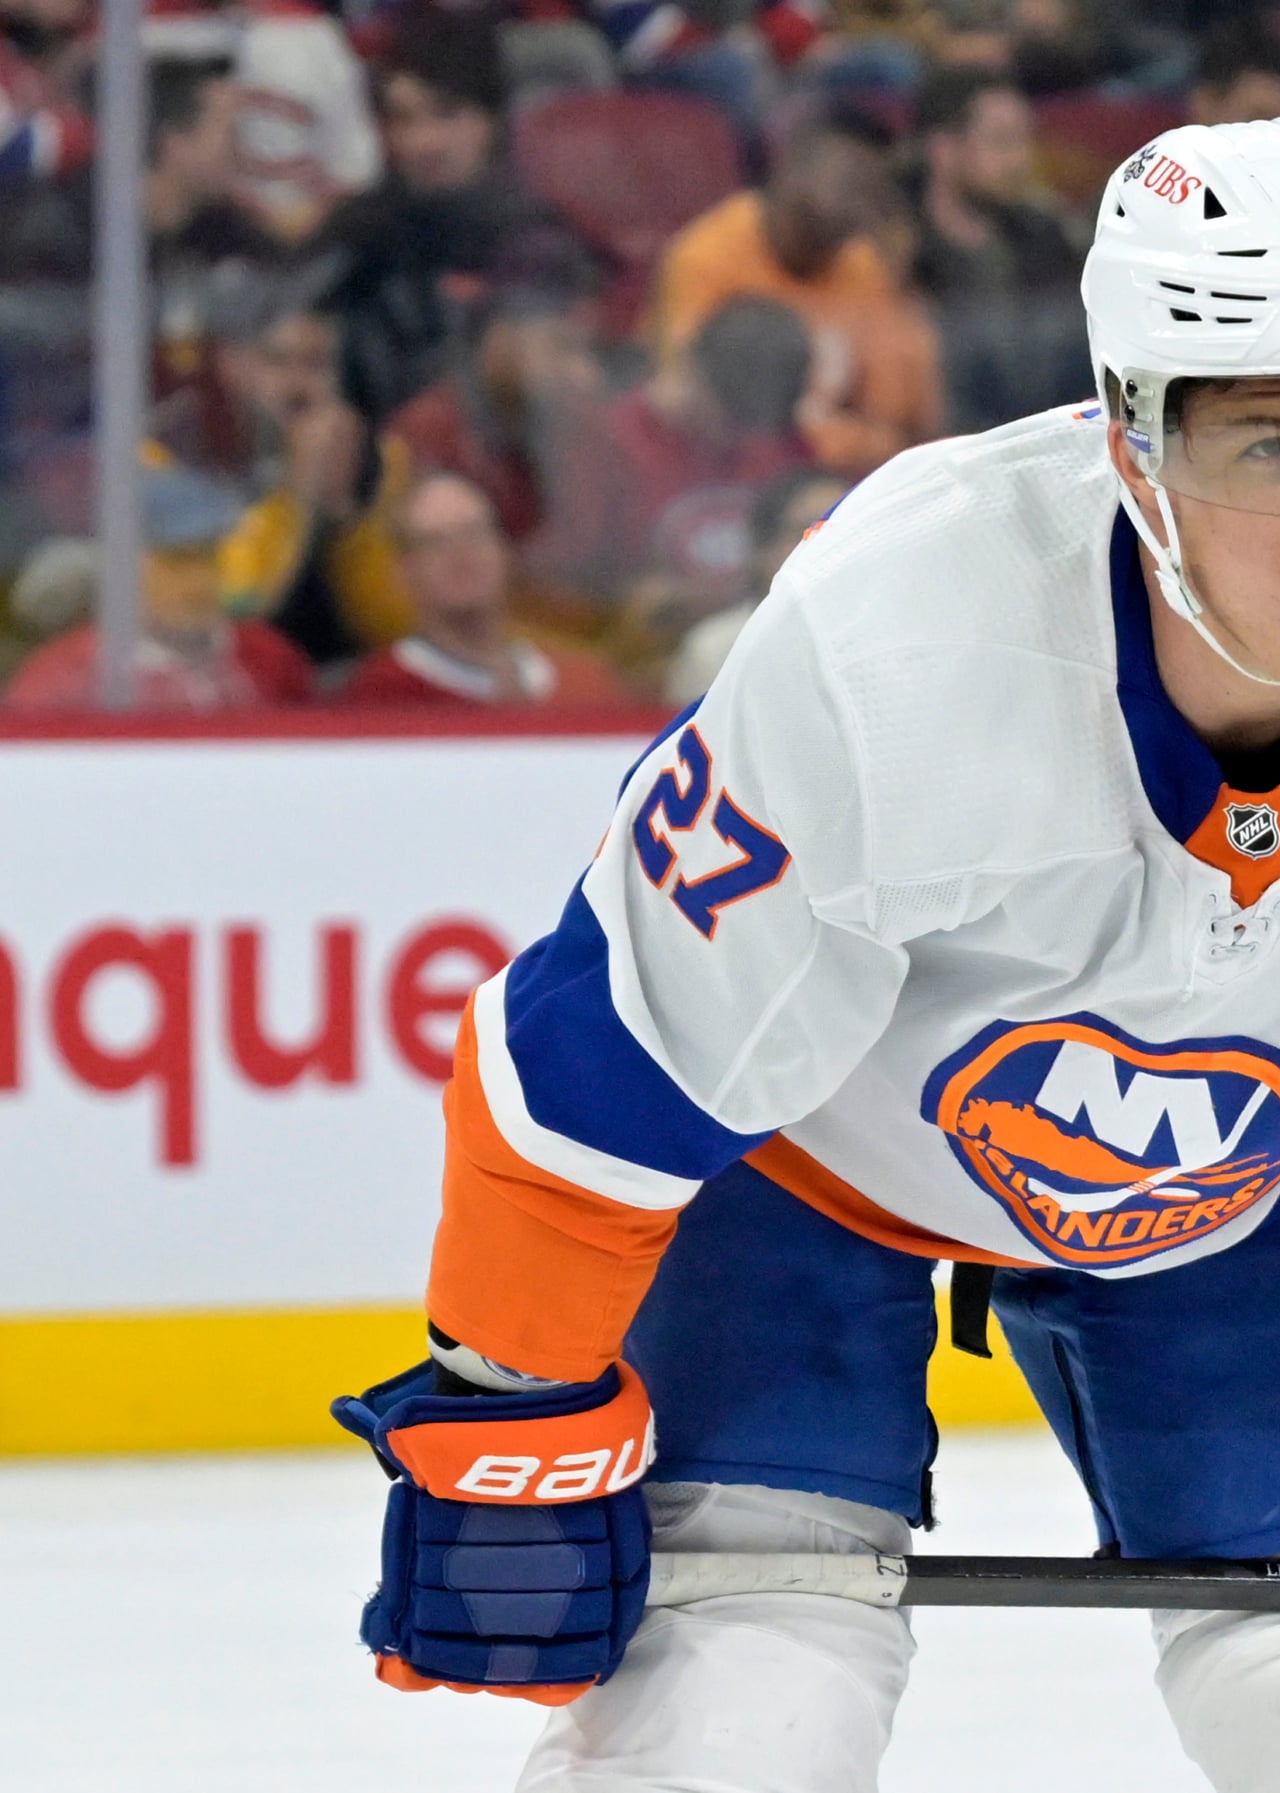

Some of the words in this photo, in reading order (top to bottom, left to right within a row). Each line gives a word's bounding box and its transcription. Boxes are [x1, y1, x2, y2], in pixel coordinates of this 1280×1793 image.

[1143, 155, 1203, 206] UBS
[632, 723, 793, 943] 27
[1237, 815, 1271, 845] NHL
[0, 918, 518, 1169] que
[973, 1138, 1265, 1248] ISLANDERS
[454, 1406, 657, 1499] BAU
